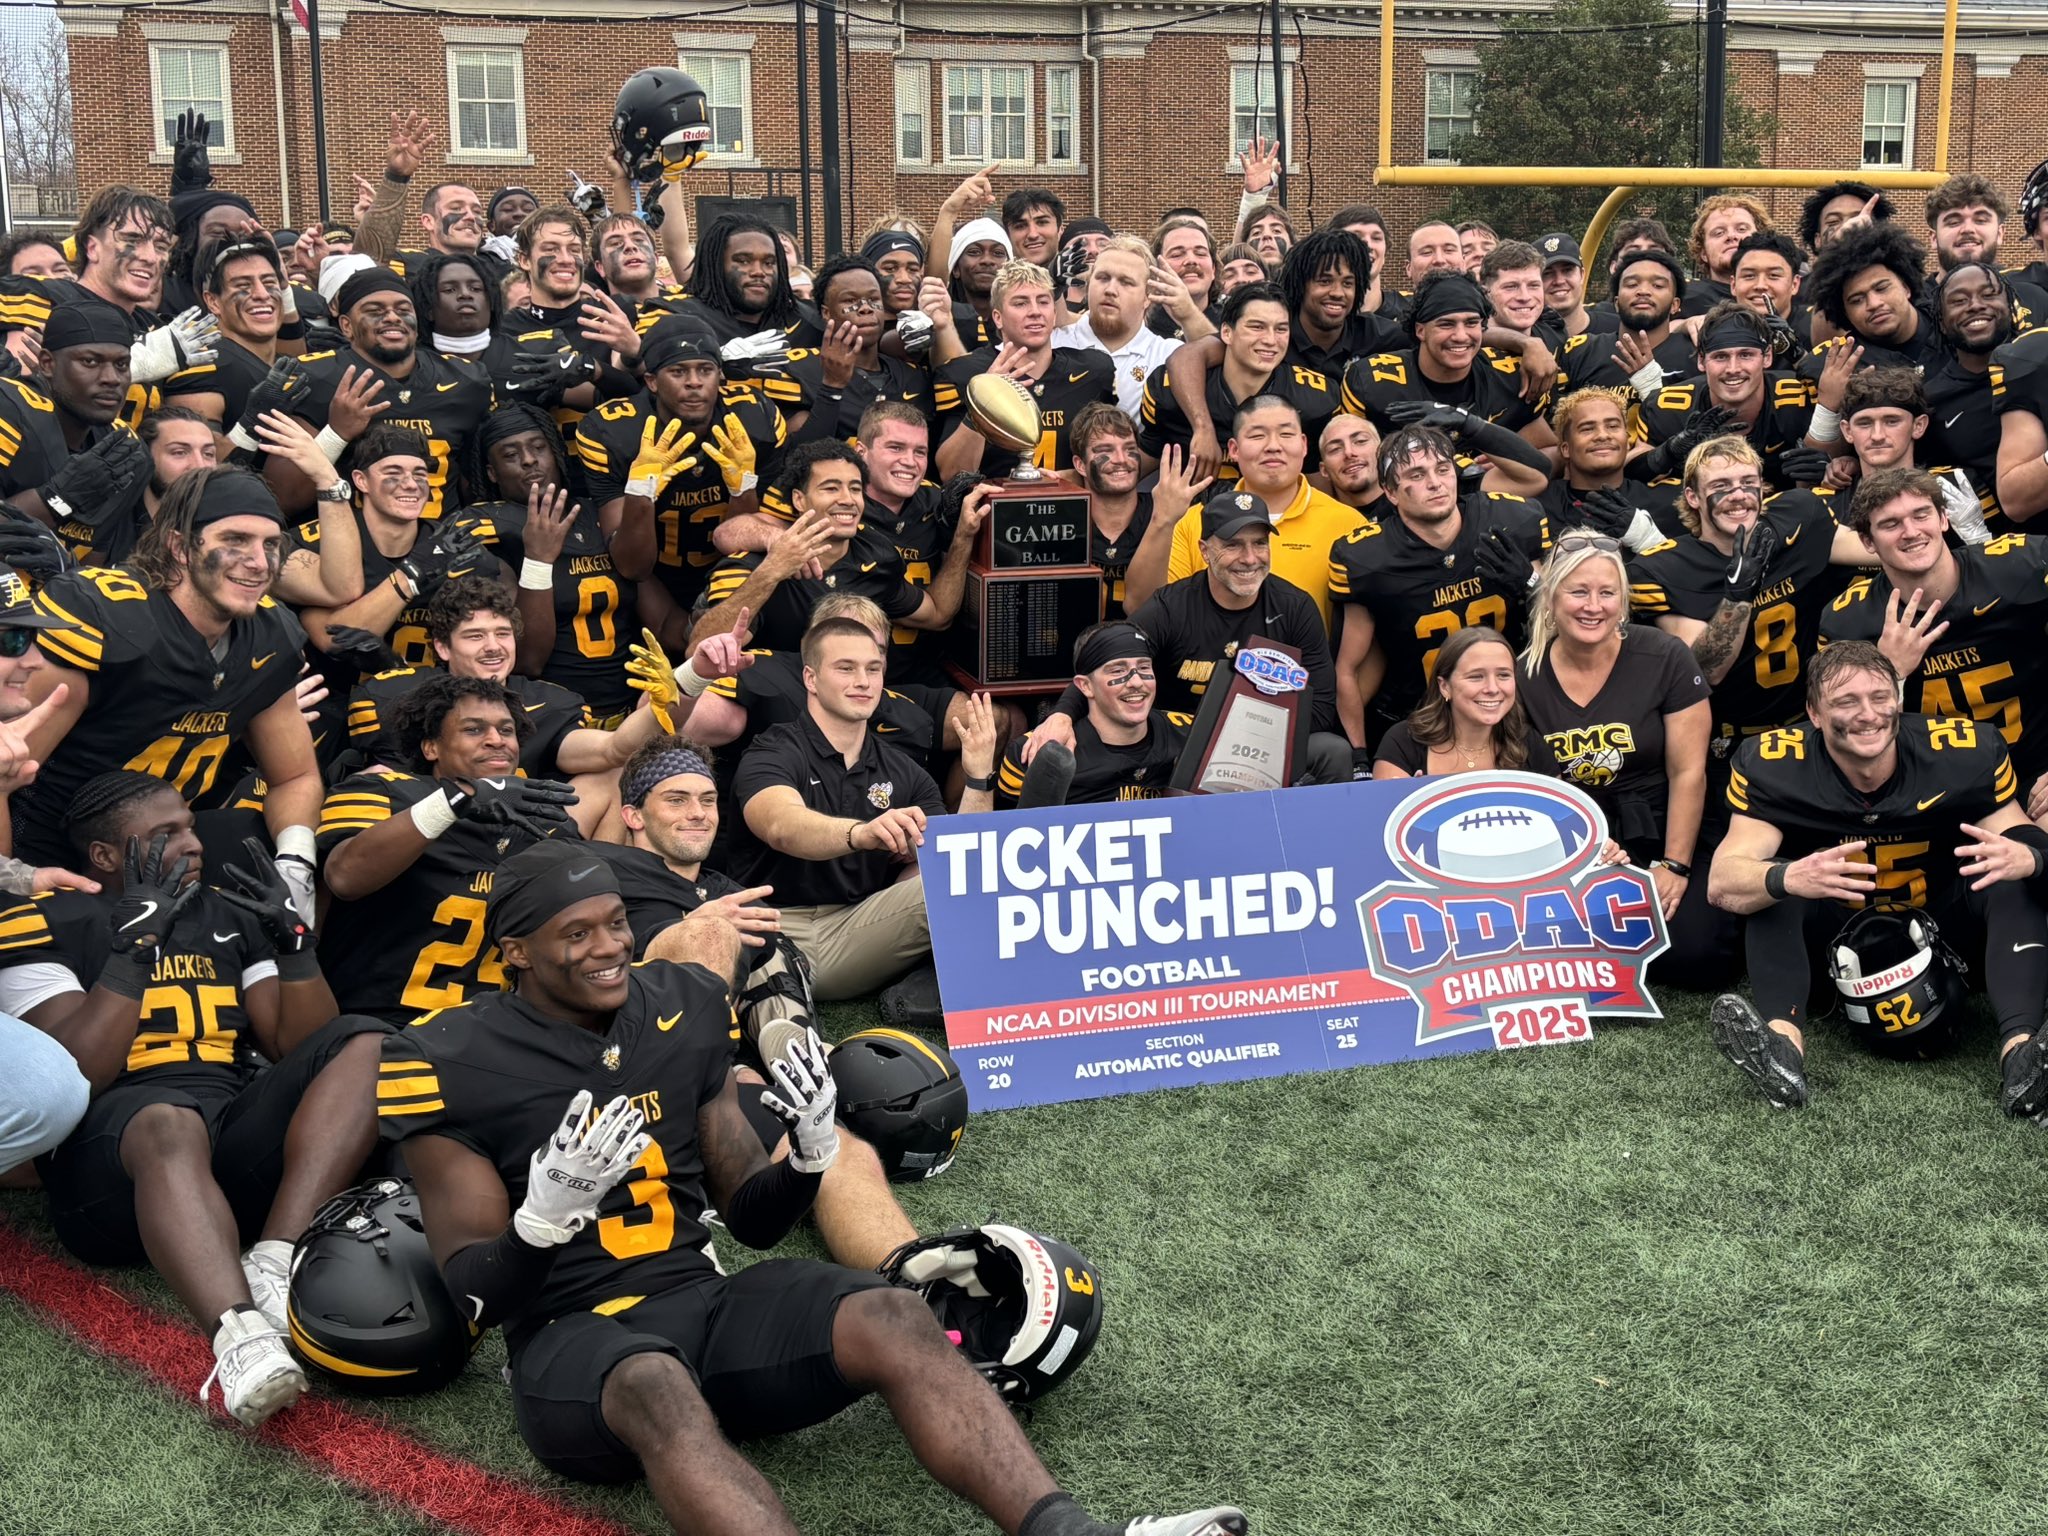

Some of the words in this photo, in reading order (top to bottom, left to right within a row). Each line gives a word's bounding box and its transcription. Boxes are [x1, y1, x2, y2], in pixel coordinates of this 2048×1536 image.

[1369, 353, 1407, 385] 47
[1657, 384, 1695, 411] 10
[1773, 378, 1807, 409] 10
[1040, 410, 1065, 427] KETS
[671, 485, 722, 507] JACKETS
[1026, 503, 1057, 516] THE
[657, 502, 732, 568] 13
[1005, 524, 1077, 544] GAME
[568, 553, 613, 575] JACKETS
[1021, 551, 1061, 564] BALL
[1432, 576, 1483, 608] JACKETS
[1753, 576, 1796, 609] ACKETS
[572, 575, 620, 659] 0
[1753, 601, 1800, 689] 8
[1238, 651, 1307, 689] ODAC
[1922, 647, 1981, 676] JACKETS
[1244, 711, 1274, 726] FOOTBALL
[1920, 661, 2024, 744] 45
[171, 711, 231, 734] JACKETS
[1926, 717, 1977, 750] 25
[1231, 743, 1271, 764] 2025
[1543, 722, 1637, 763] RMC
[1759, 728, 1805, 760] 25
[936, 816, 1173, 896] TICKET
[998, 866, 1338, 959] PUNCHED!
[1374, 875, 1656, 973] ODAC
[150, 954, 217, 982] JACKETS
[1081, 955, 1241, 992] FOOTBALL
[1442, 960, 1617, 1005] CHAMPIONS
[1852, 964, 1914, 996] Riddell
[987, 1011, 1053, 1035] NCAA
[1058, 1000, 1157, 1027] DIVISION
[1164, 996, 1183, 1016] III
[1188, 980, 1340, 1013] TOURNAMENT
[1326, 1016, 1359, 1031] SEAT
[1875, 992, 1921, 1033] 25
[127, 984, 240, 1072] 25
[1495, 1003, 1587, 1046] 2025
[1145, 1033, 1204, 1050] SECTION
[1336, 1034, 1358, 1049] 25
[978, 1055, 1014, 1070] ROW
[1075, 1052, 1183, 1079] AUTOMATIC
[1187, 1042, 1281, 1067] QUALIFIER
[987, 1072, 1012, 1090] 20
[598, 1134, 675, 1260] 3
[1064, 1266, 1095, 1297] 3
